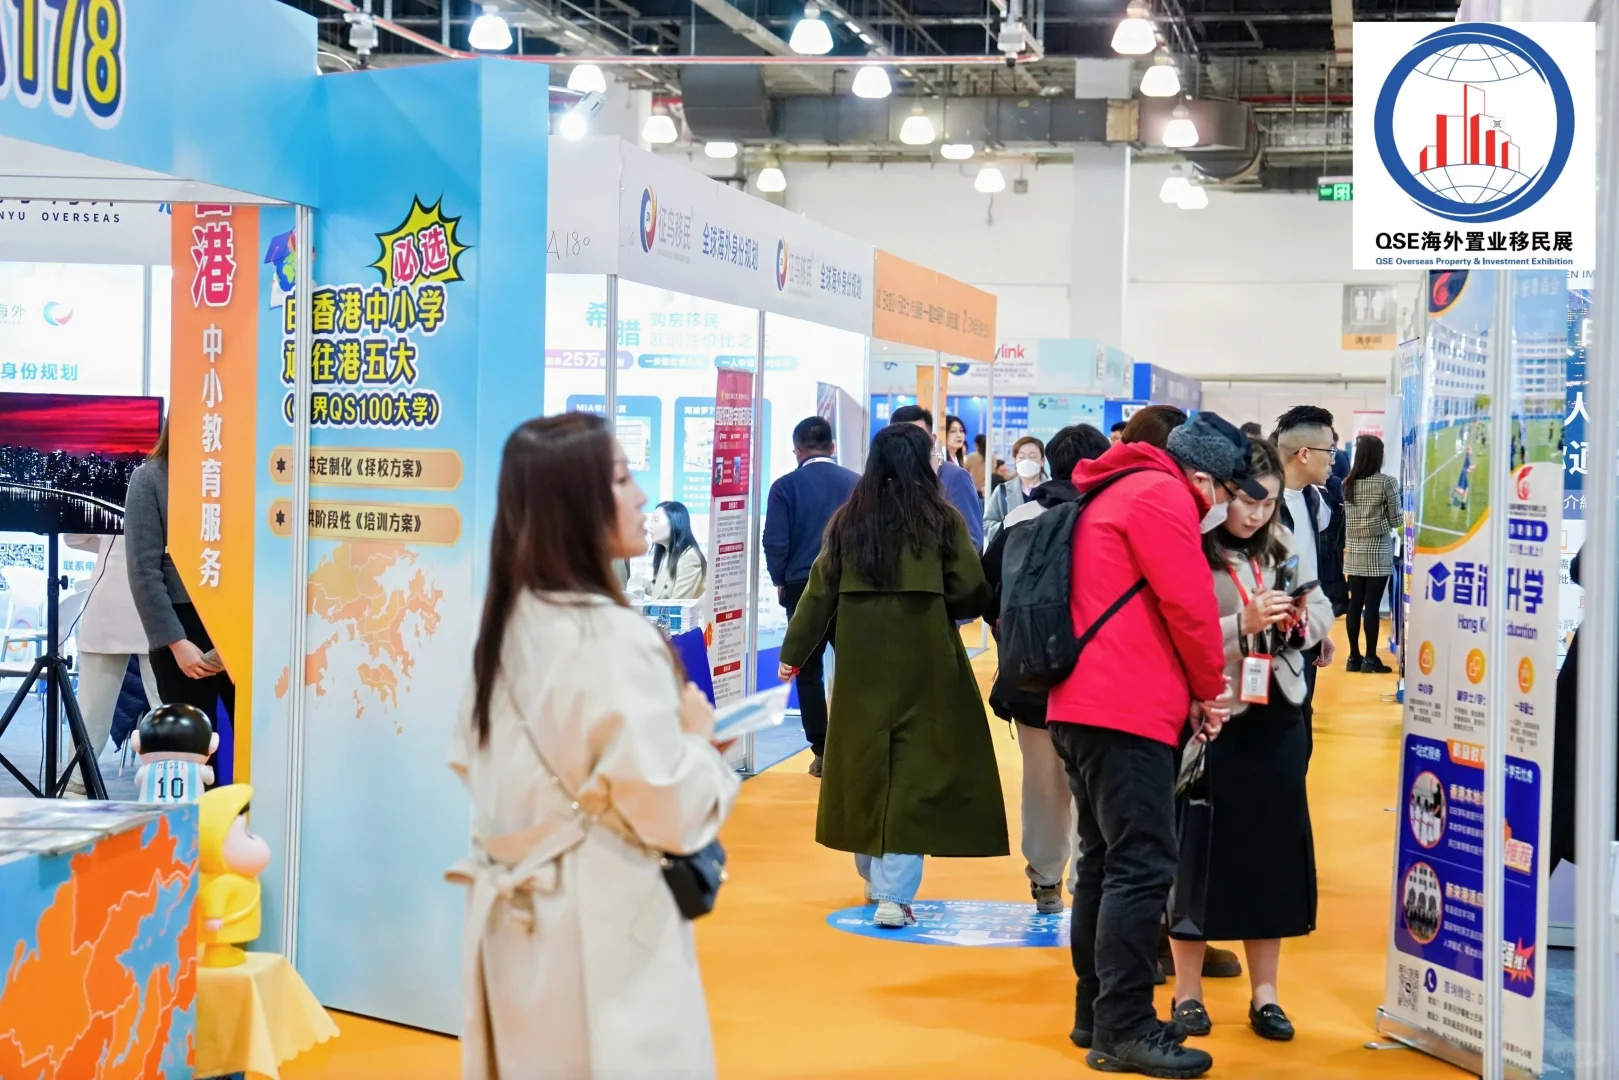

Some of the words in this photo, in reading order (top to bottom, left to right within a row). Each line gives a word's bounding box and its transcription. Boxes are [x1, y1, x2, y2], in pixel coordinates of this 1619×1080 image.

[0, 0, 122, 118] 178
[41, 211, 120, 223] OVERSEAS
[191, 204, 236, 308] 港
[394, 226, 448, 282] 必选
[702, 222, 758, 271] 全球海外身份规划
[820, 262, 862, 300] 全球海外身份规划
[651, 312, 719, 329] 购房移民
[286, 395, 438, 424] (界QS100大学)
[199, 323, 223, 588] 中小教育服务
[1457, 614, 1477, 633] Hong
[157, 777, 184, 799] 10
